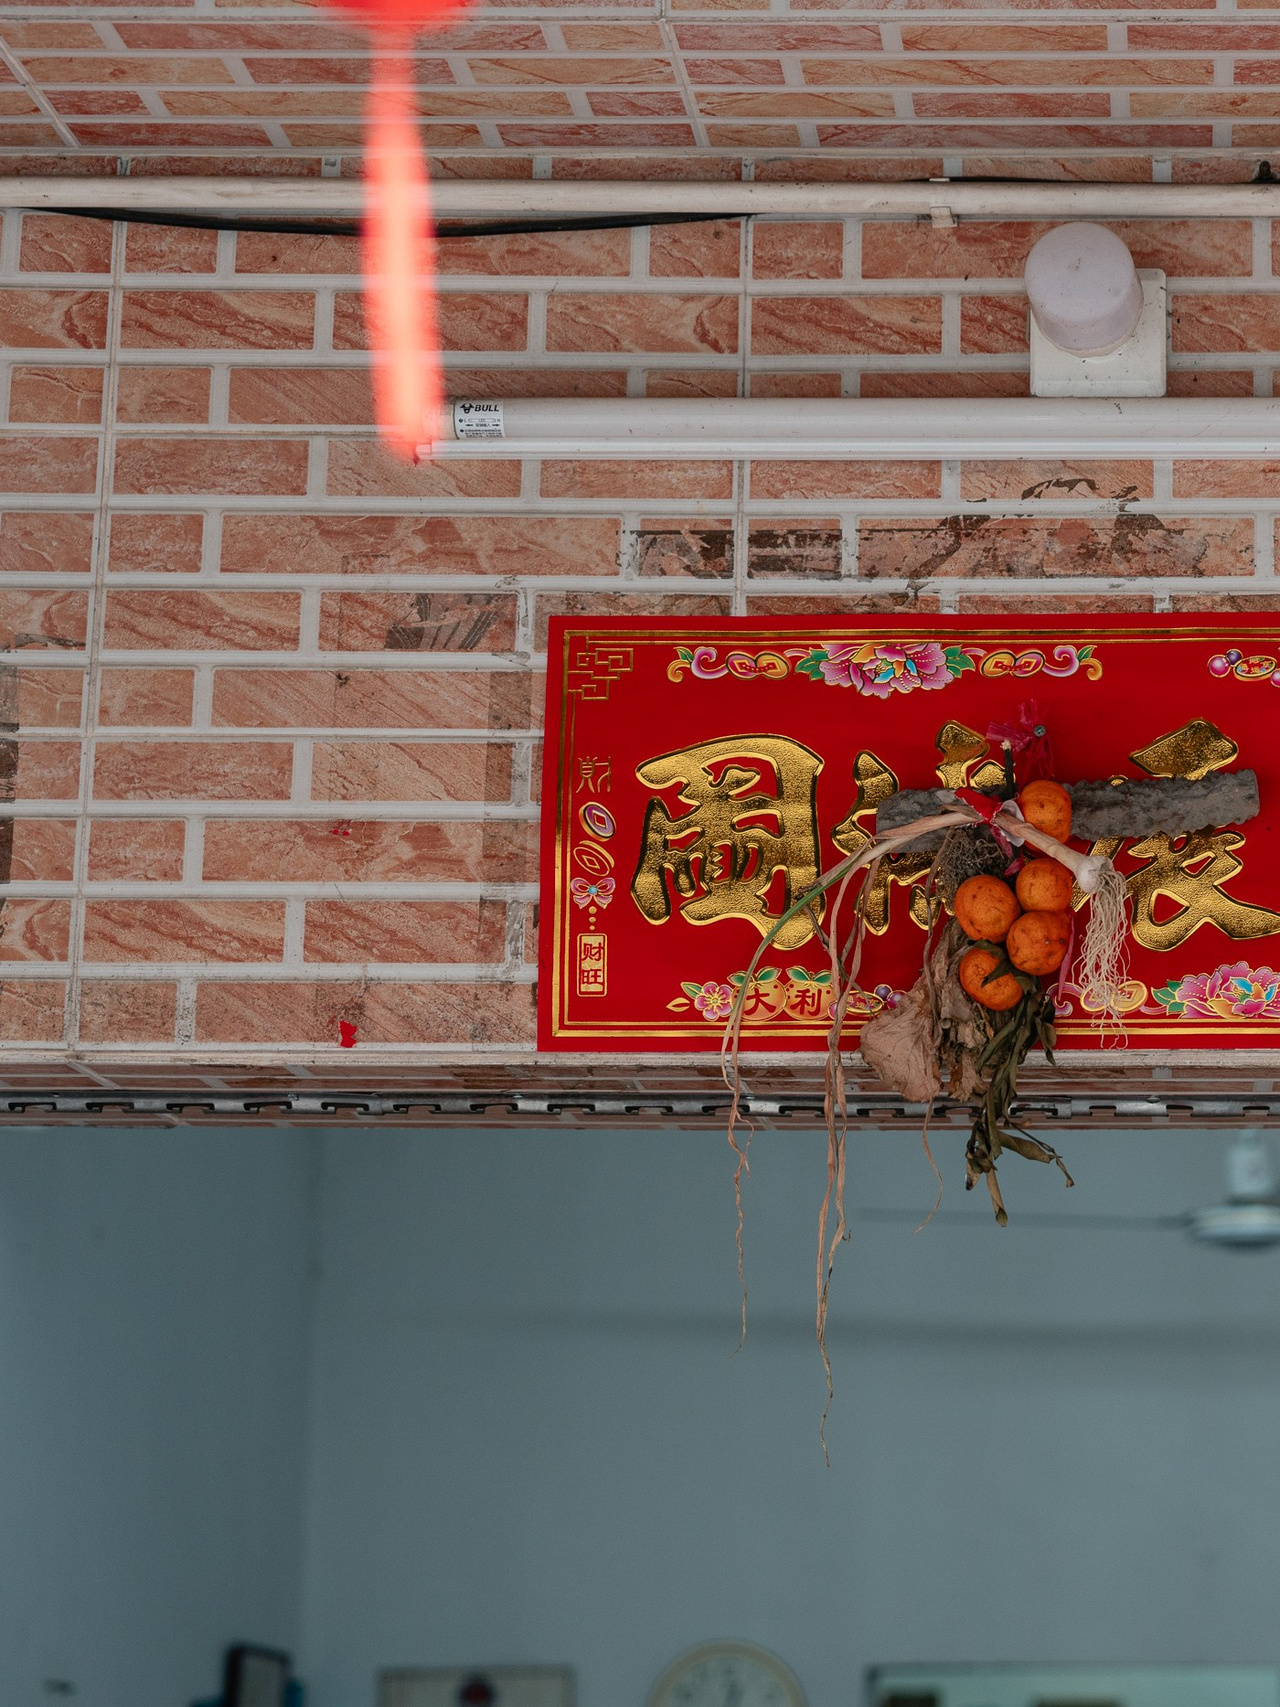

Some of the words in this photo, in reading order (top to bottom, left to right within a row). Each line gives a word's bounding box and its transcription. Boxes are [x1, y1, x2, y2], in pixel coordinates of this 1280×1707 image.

[474, 404, 500, 412] BULL
[581, 942, 605, 985] 财旺
[743, 987, 823, 1017] 大利
